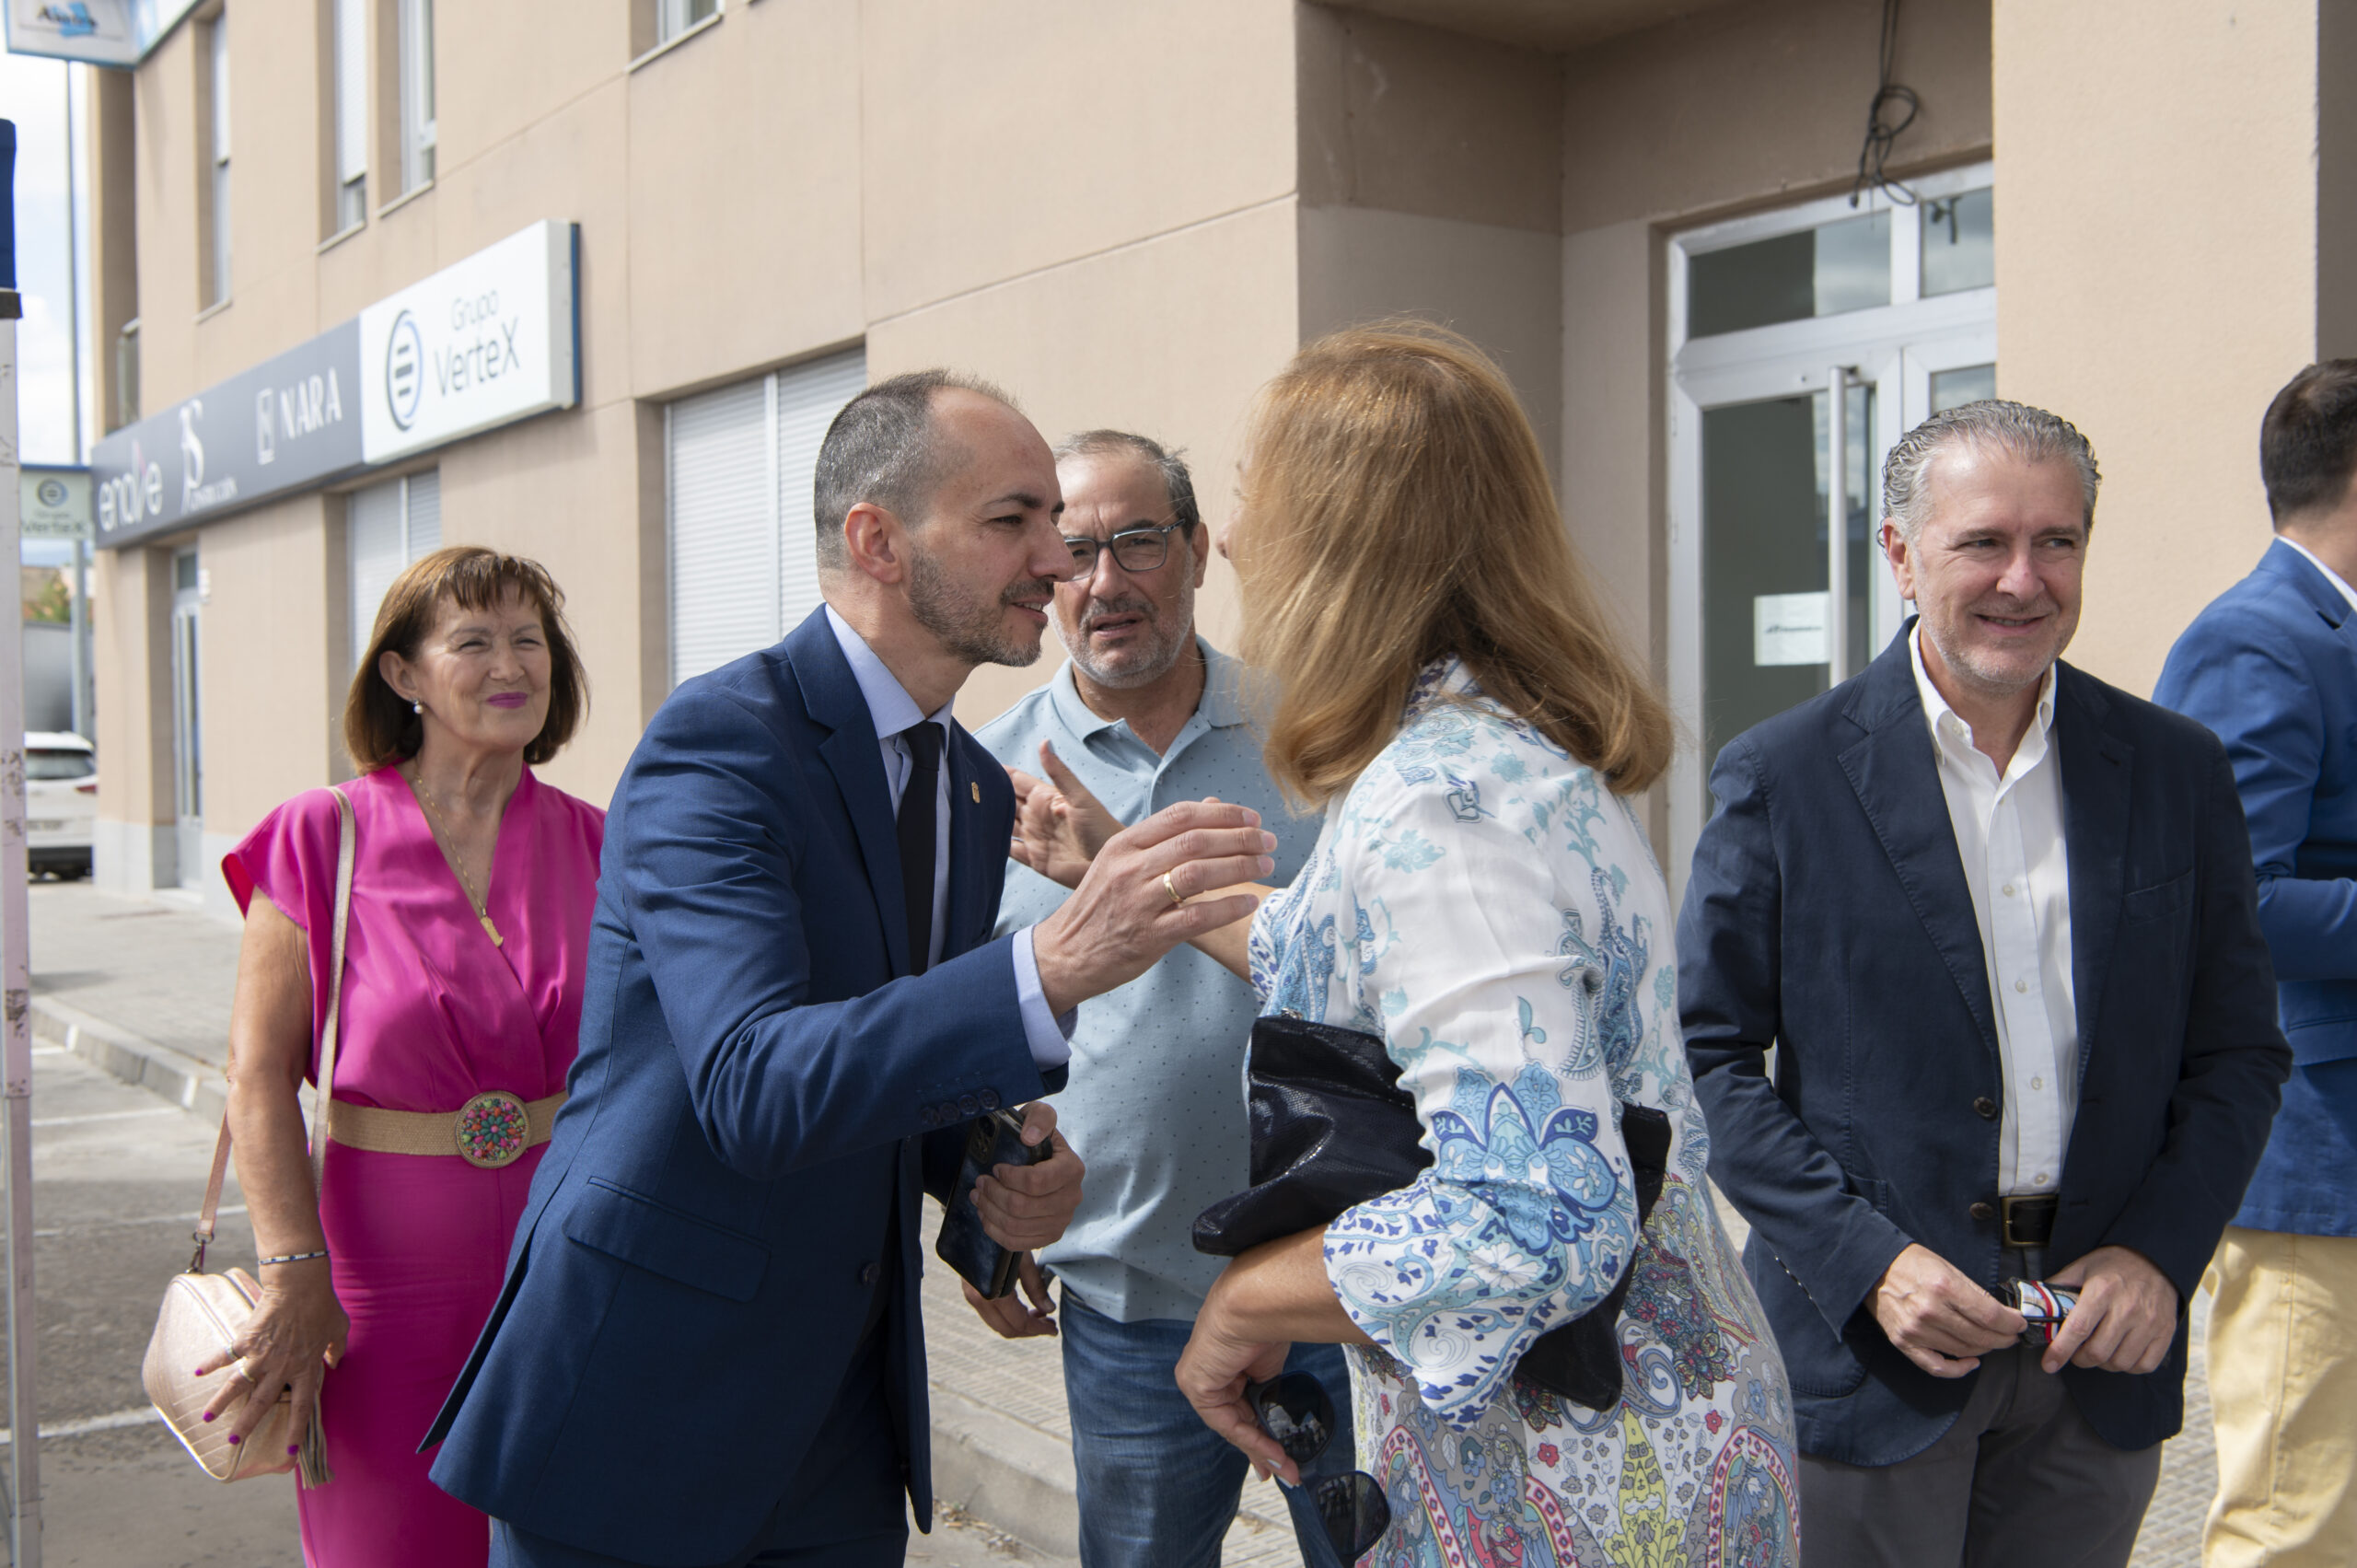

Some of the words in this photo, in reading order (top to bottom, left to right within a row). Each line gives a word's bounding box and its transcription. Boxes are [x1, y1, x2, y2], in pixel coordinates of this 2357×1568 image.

[451, 289, 499, 333] Grupo
[435, 316, 520, 397] VerteX
[281, 366, 343, 440] NARA
